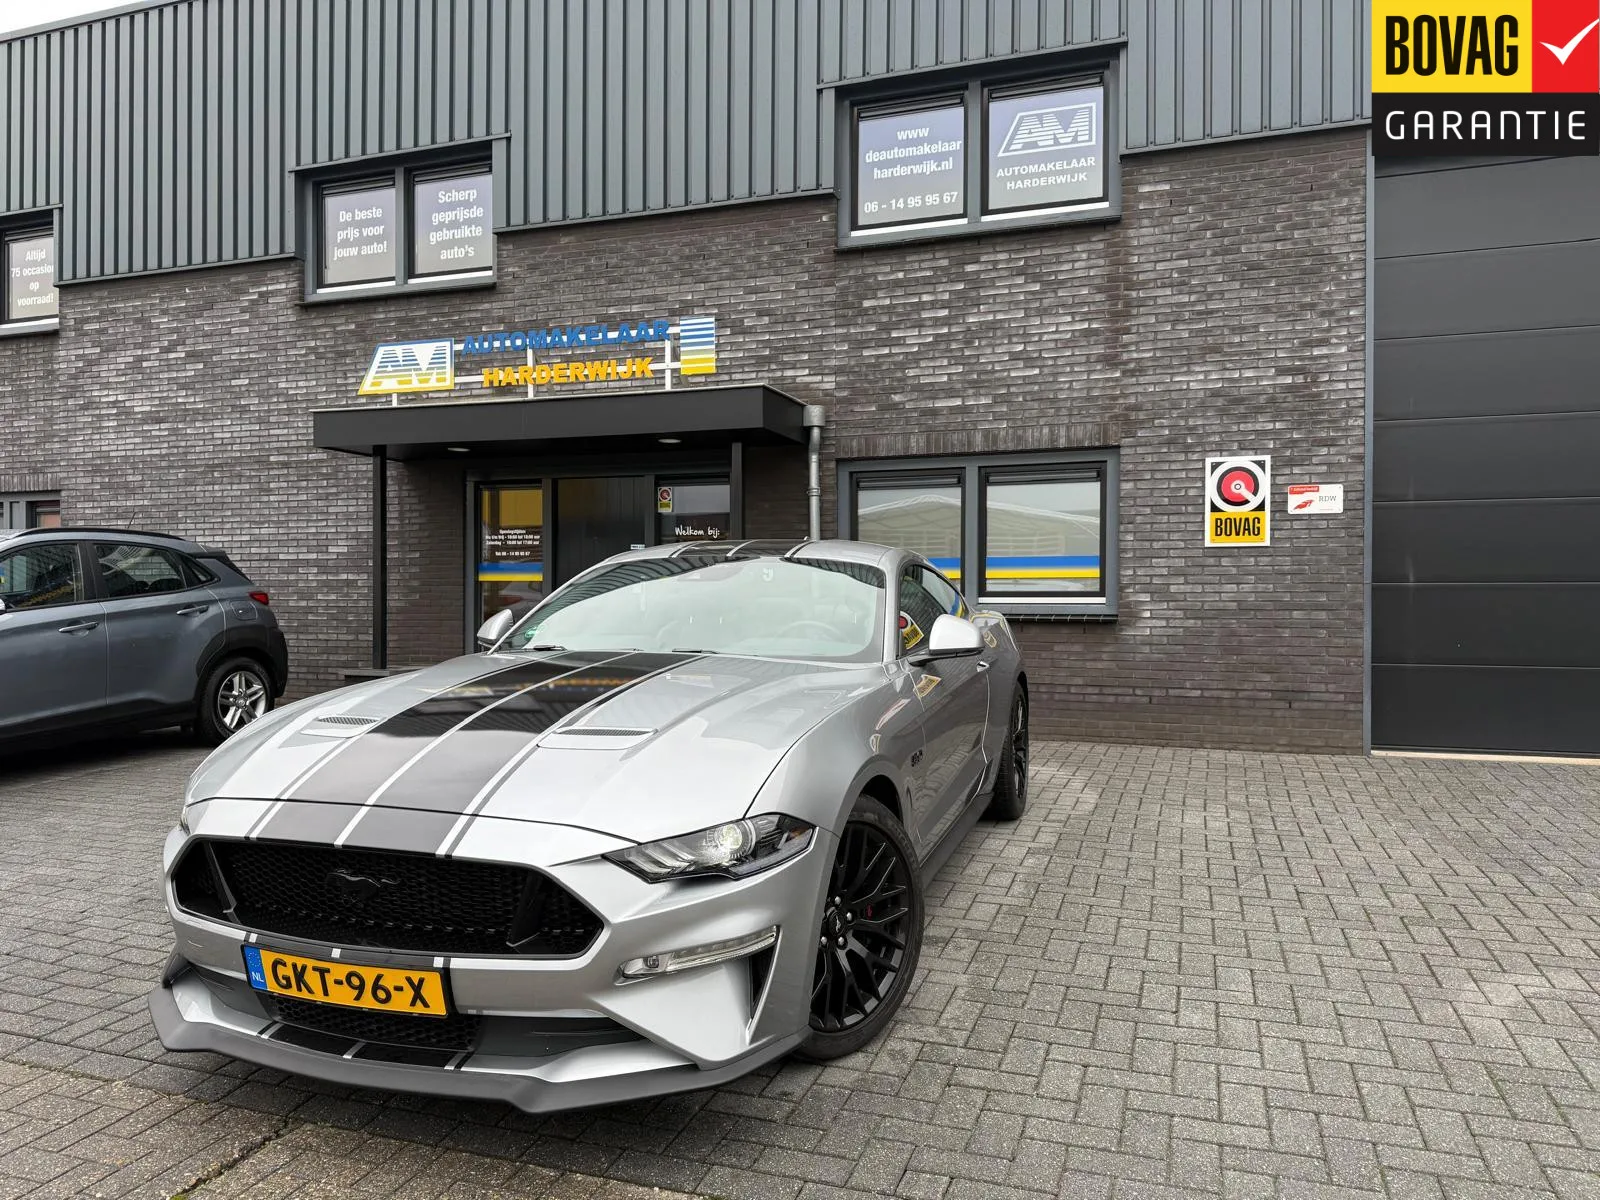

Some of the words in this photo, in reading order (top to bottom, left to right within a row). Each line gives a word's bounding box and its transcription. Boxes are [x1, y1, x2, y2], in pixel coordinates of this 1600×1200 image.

[897, 126, 930, 141] www
[865, 140, 962, 163] deautomakelaar
[873, 158, 953, 179] harderwijk.nl
[996, 156, 1096, 178] AUTOMAKELAAR
[1006, 172, 1088, 191] HARDERWIJK
[438, 189, 477, 204] Scherp
[864, 199, 879, 213] 06
[890, 197, 904, 210] 14
[907, 195, 922, 208] 95
[925, 193, 940, 206] 95
[943, 191, 958, 204] 67
[339, 211, 352, 222] De
[354, 206, 383, 220] beste
[432, 205, 484, 225] geprijsde
[337, 227, 360, 243] prijs
[362, 224, 385, 237] voor
[429, 225, 483, 245] gebruikte
[25, 249, 46, 262] Altijd
[333, 246, 358, 261] jouw
[361, 241, 387, 255] auto!
[440, 245, 475, 260] auto's
[11, 267, 21, 278] 75
[29, 281, 39, 292] op
[461, 319, 671, 356] AUTOMAKELAAR
[482, 356, 654, 388] HARDERWIJK
[674, 523, 705, 536] Welkom
[707, 525, 720, 539] bij:
[1214, 516, 1261, 537] BOVAG
[252, 971, 265, 983] NL
[271, 957, 431, 1009] GKT-96-X
